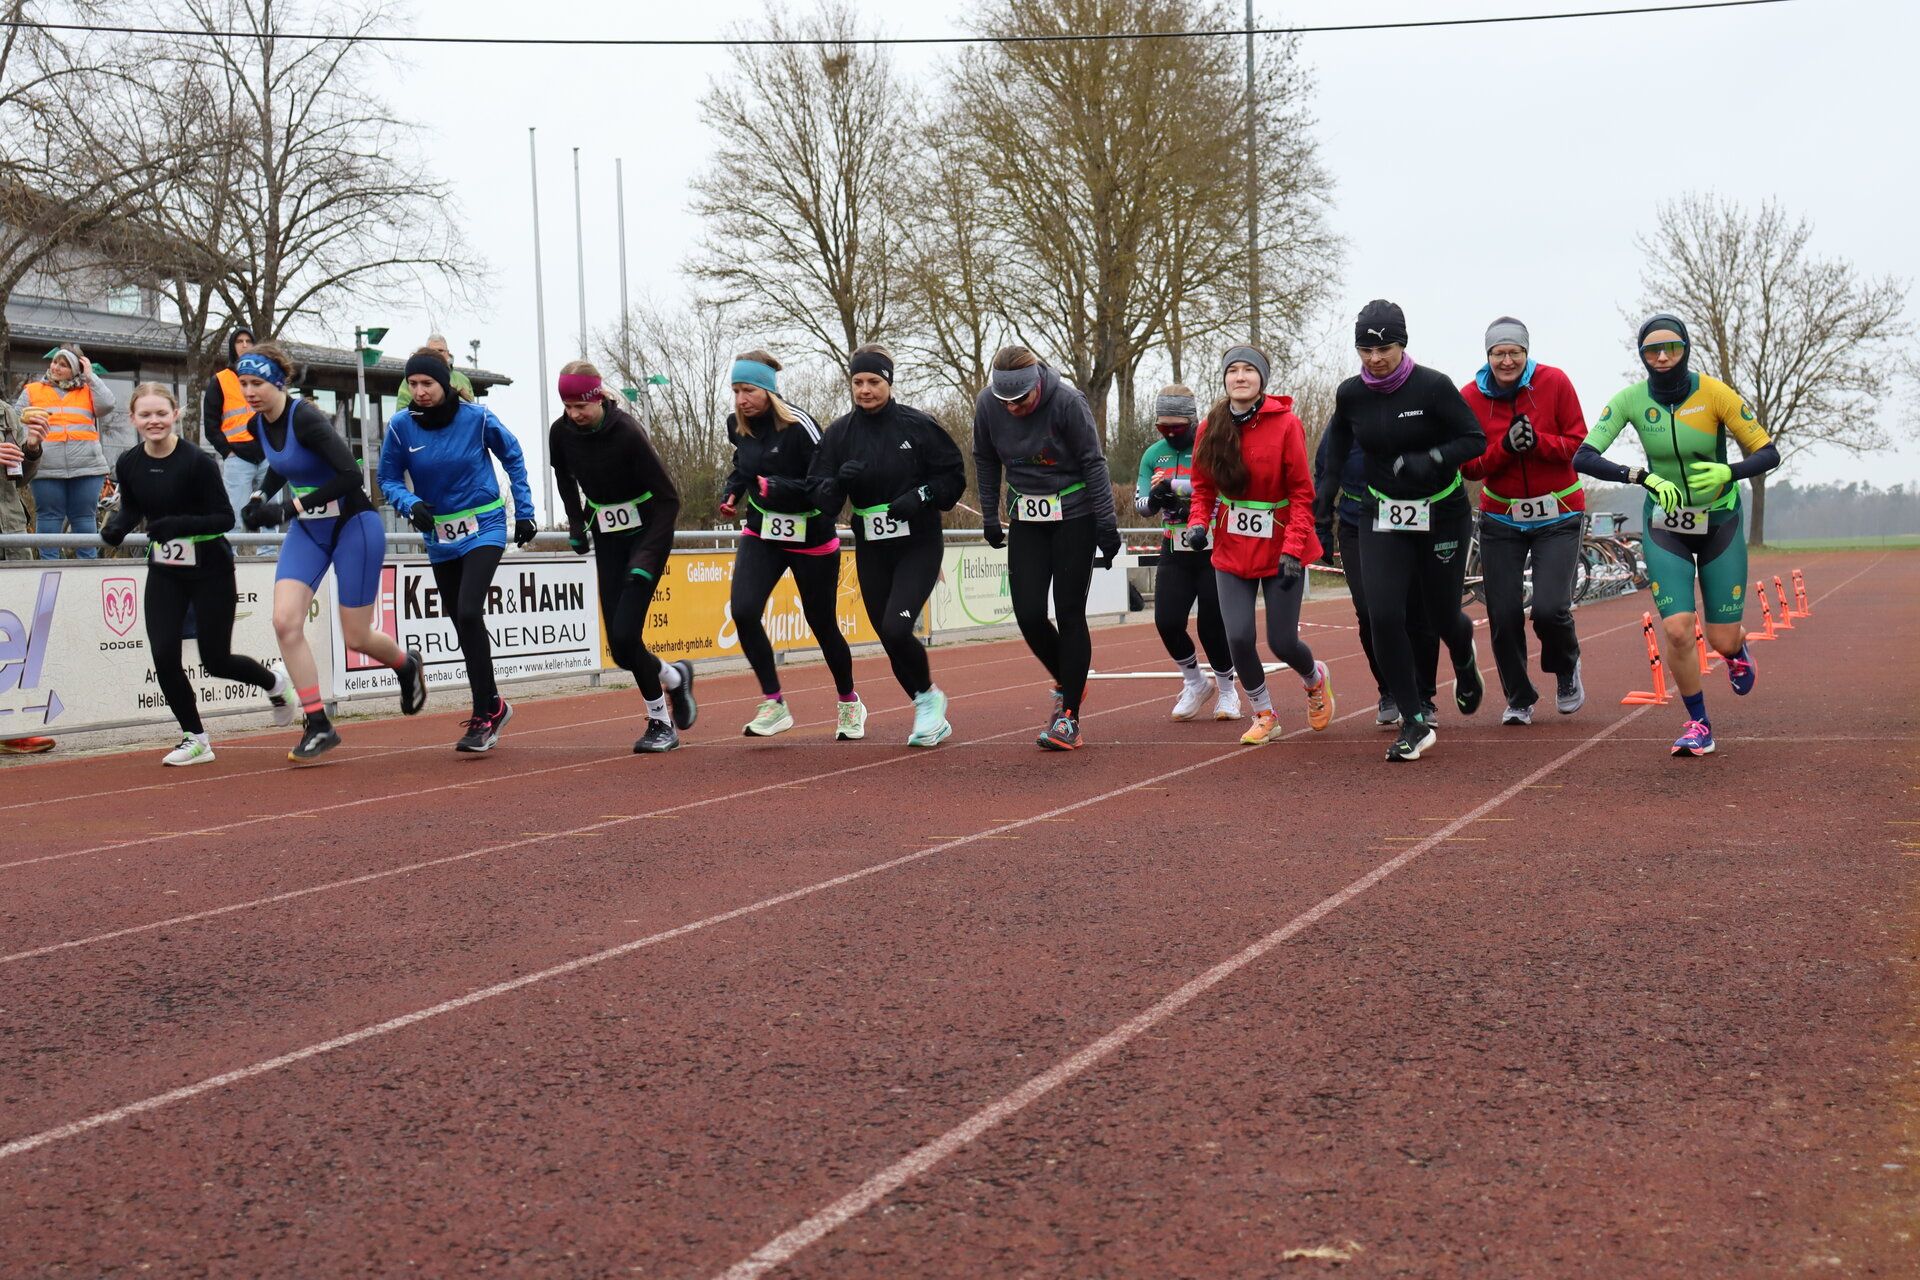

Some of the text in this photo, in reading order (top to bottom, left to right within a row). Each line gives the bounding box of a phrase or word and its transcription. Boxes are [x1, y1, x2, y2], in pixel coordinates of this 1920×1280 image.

[605, 508, 629, 528] 90
[1026, 499, 1051, 518] 80
[1390, 505, 1417, 526] 82
[1520, 501, 1549, 519] 91
[444, 520, 470, 540] 84
[770, 518, 795, 537] 83
[872, 516, 898, 536] 85
[1236, 512, 1262, 533] 86
[1664, 510, 1696, 530] 88
[161, 542, 185, 561] 92
[687, 561, 722, 583] Geländer
[665, 587, 671, 601] 5
[653, 614, 668, 628] 354
[100, 640, 143, 651] DODGE
[405, 623, 586, 654] BRUNENBAU
[345, 677, 369, 690] Keller
[371, 676, 378, 688] &
[524, 656, 592, 673] www.keller-hahn.de
[200, 686, 222, 702] Tel.:
[225, 684, 257, 701] 09872
